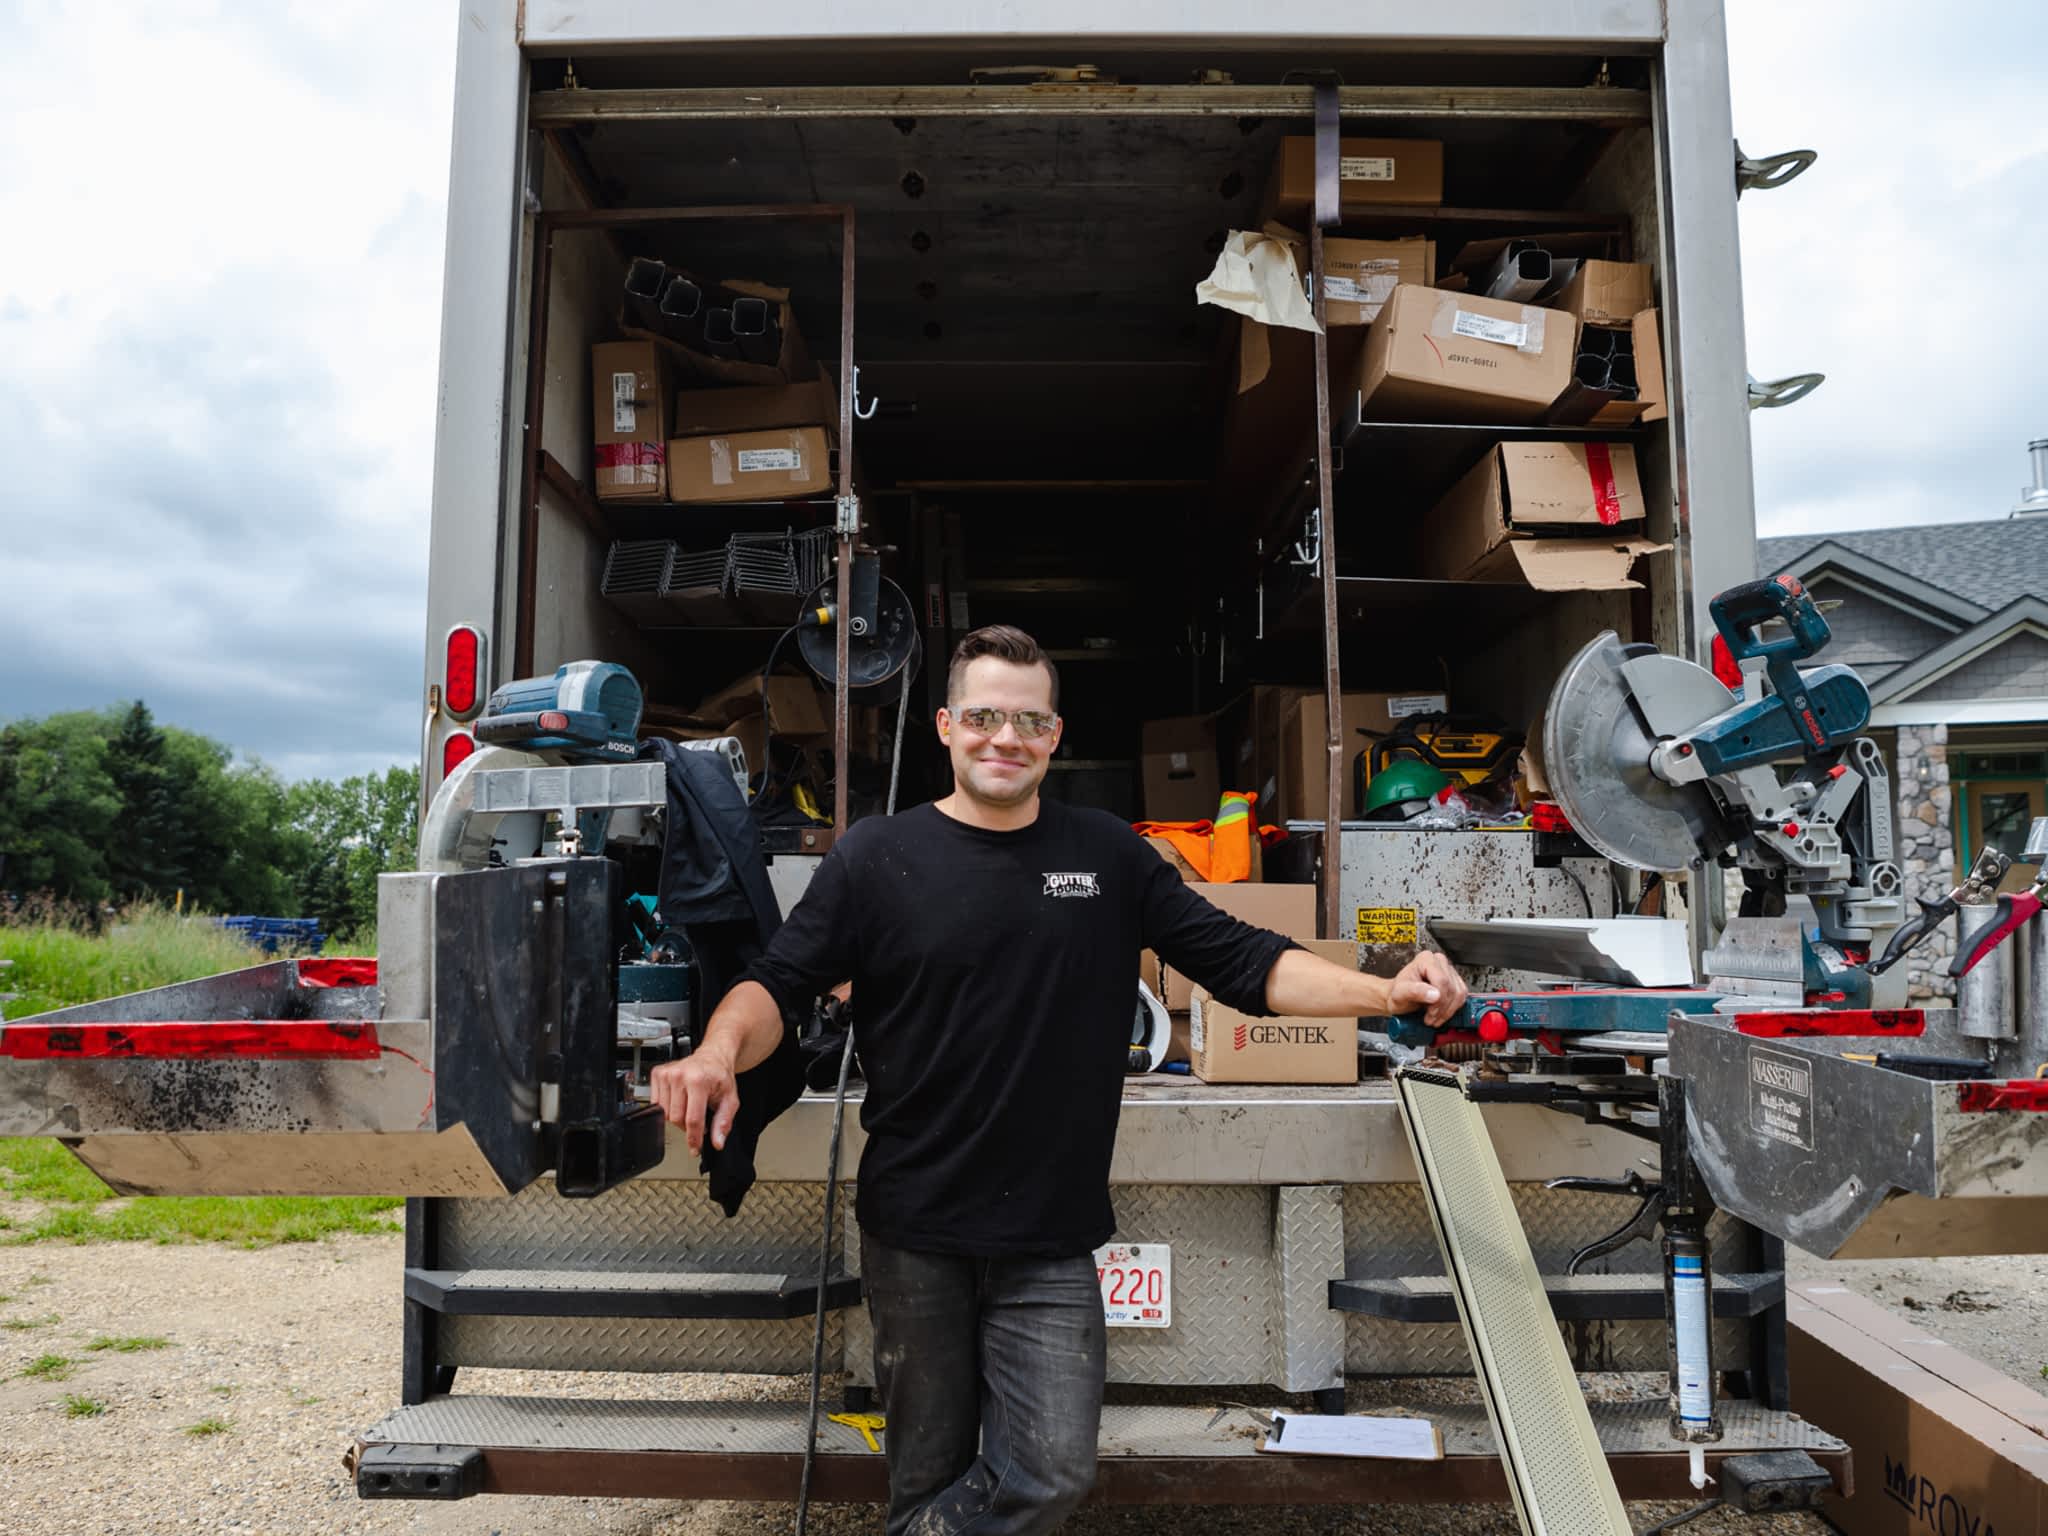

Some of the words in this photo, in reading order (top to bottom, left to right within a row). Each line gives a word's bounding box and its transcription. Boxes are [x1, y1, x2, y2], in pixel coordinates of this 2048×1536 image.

[1800, 709, 1826, 747] BOSCH
[607, 741, 636, 754] BOSCH
[1874, 804, 1890, 857] BOSCH
[1049, 874, 1095, 889] GUTTER
[1362, 911, 1410, 921] WARNING
[1250, 1025, 1329, 1044] GENTEK
[1150, 1310, 1160, 1318] 19
